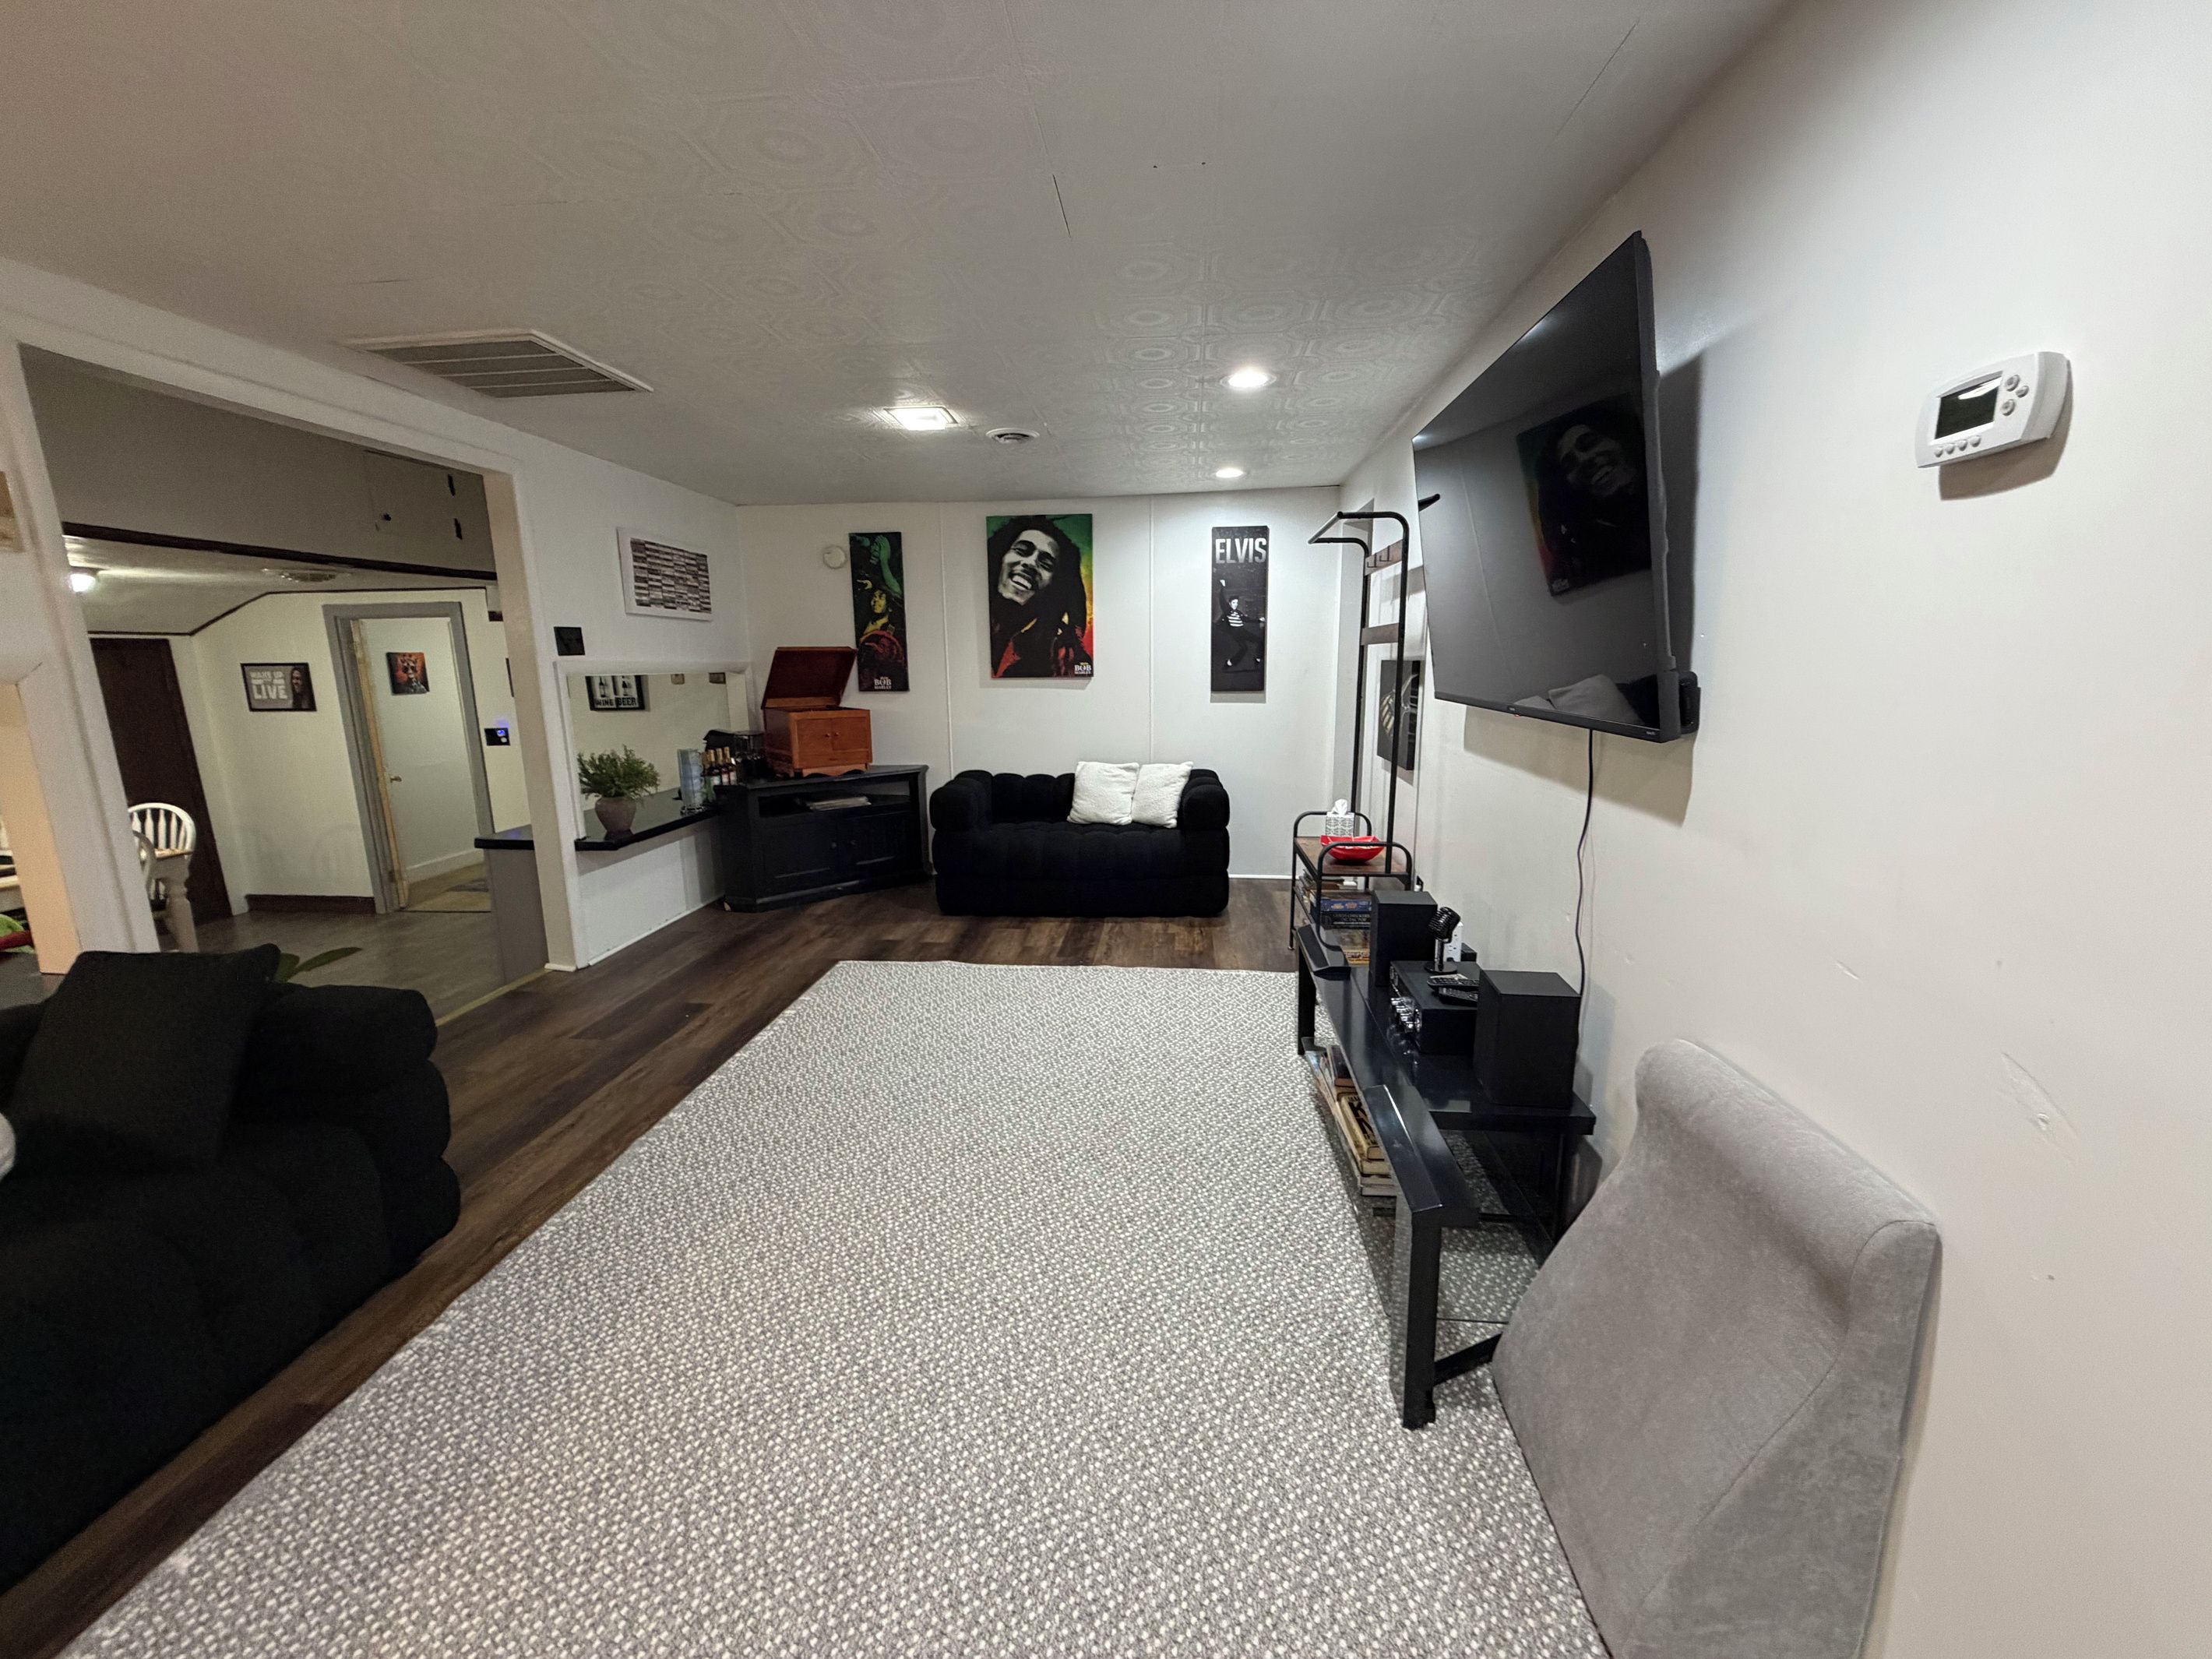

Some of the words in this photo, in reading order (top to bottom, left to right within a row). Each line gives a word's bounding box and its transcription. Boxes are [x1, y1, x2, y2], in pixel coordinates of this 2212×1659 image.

[1215, 537, 1267, 564] ELVIS
[252, 685, 288, 699] LIVE
[615, 697, 637, 706] BEER
